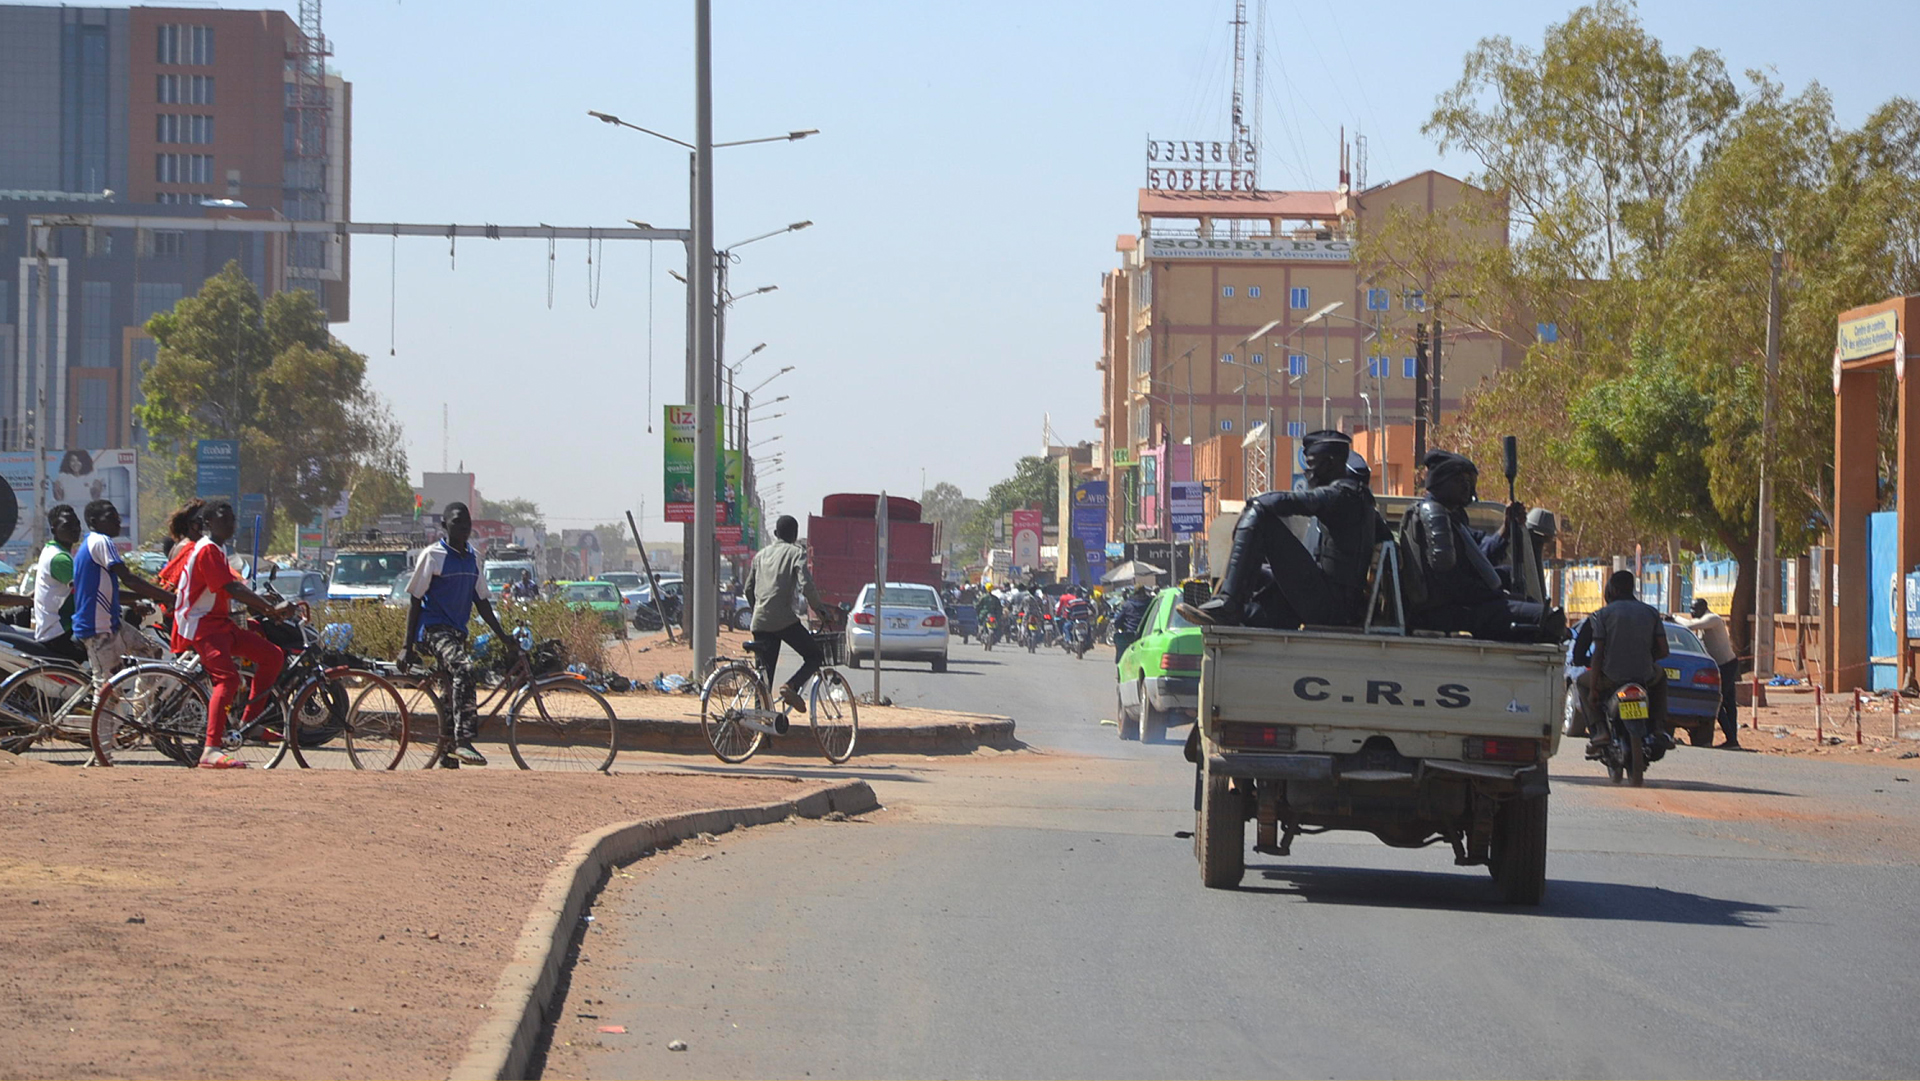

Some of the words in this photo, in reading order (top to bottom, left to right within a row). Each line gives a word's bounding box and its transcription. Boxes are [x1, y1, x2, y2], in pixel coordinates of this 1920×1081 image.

[1150, 169, 1255, 191] SOBELEC
[1153, 239, 1350, 251] SOBELEC
[1153, 249, 1243, 258] Quincaillerie
[1271, 251, 1350, 260] Décoration
[203, 443, 231, 454] Ecobank
[1293, 676, 1472, 709] C.R.S
